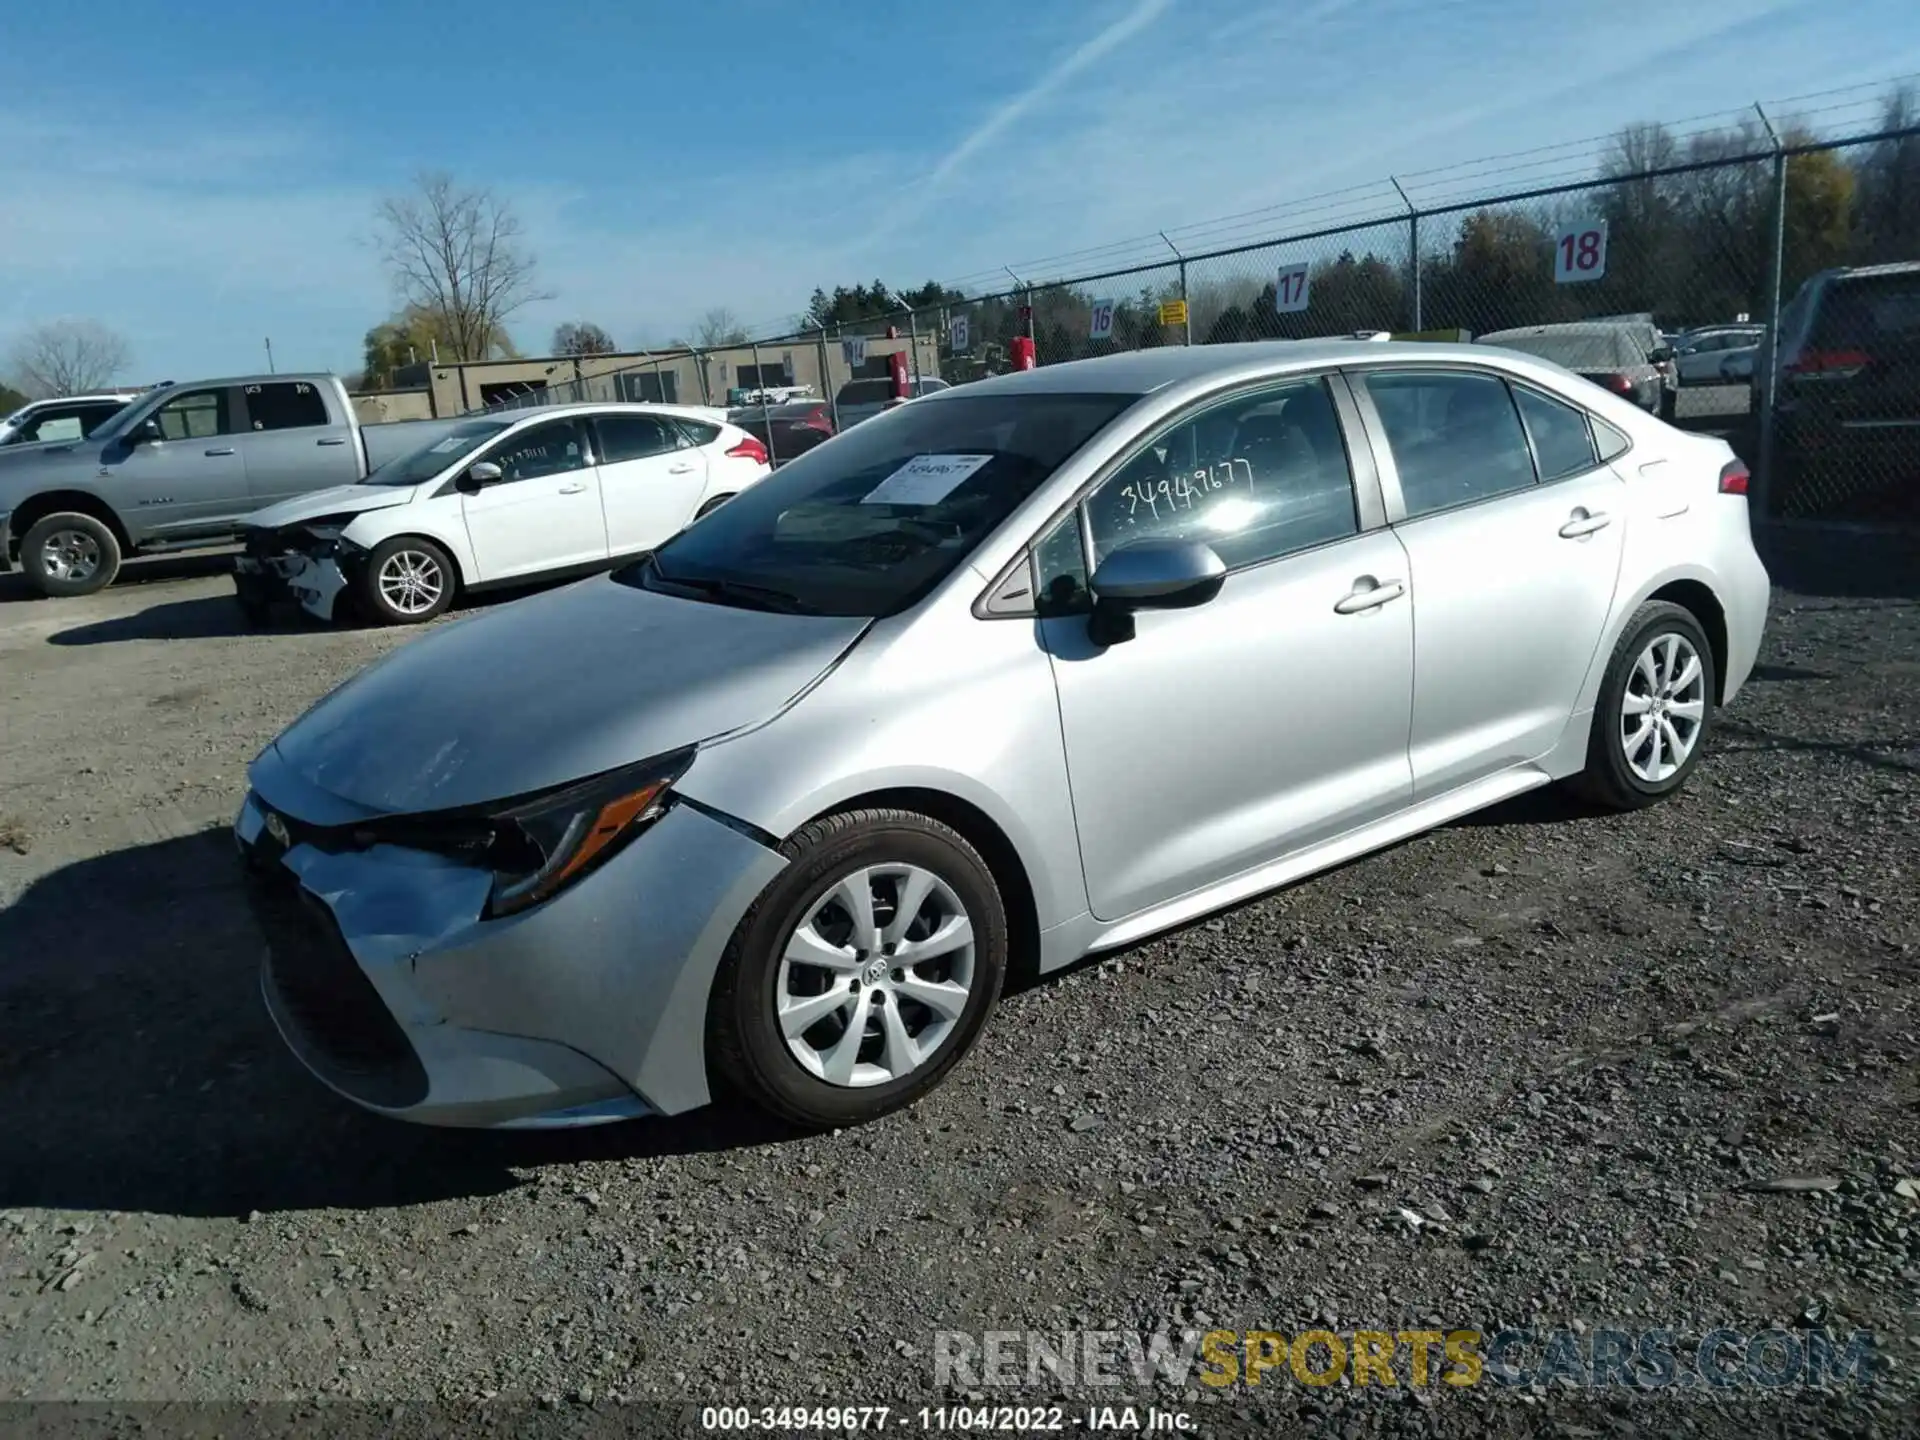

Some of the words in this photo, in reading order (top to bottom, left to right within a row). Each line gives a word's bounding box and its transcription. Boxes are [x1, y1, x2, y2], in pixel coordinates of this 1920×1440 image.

[1559, 230, 1601, 272] 18
[1279, 271, 1306, 305] 17
[953, 321, 967, 347] 15
[1093, 305, 1112, 332] 16
[1120, 458, 1255, 521] 34949677
